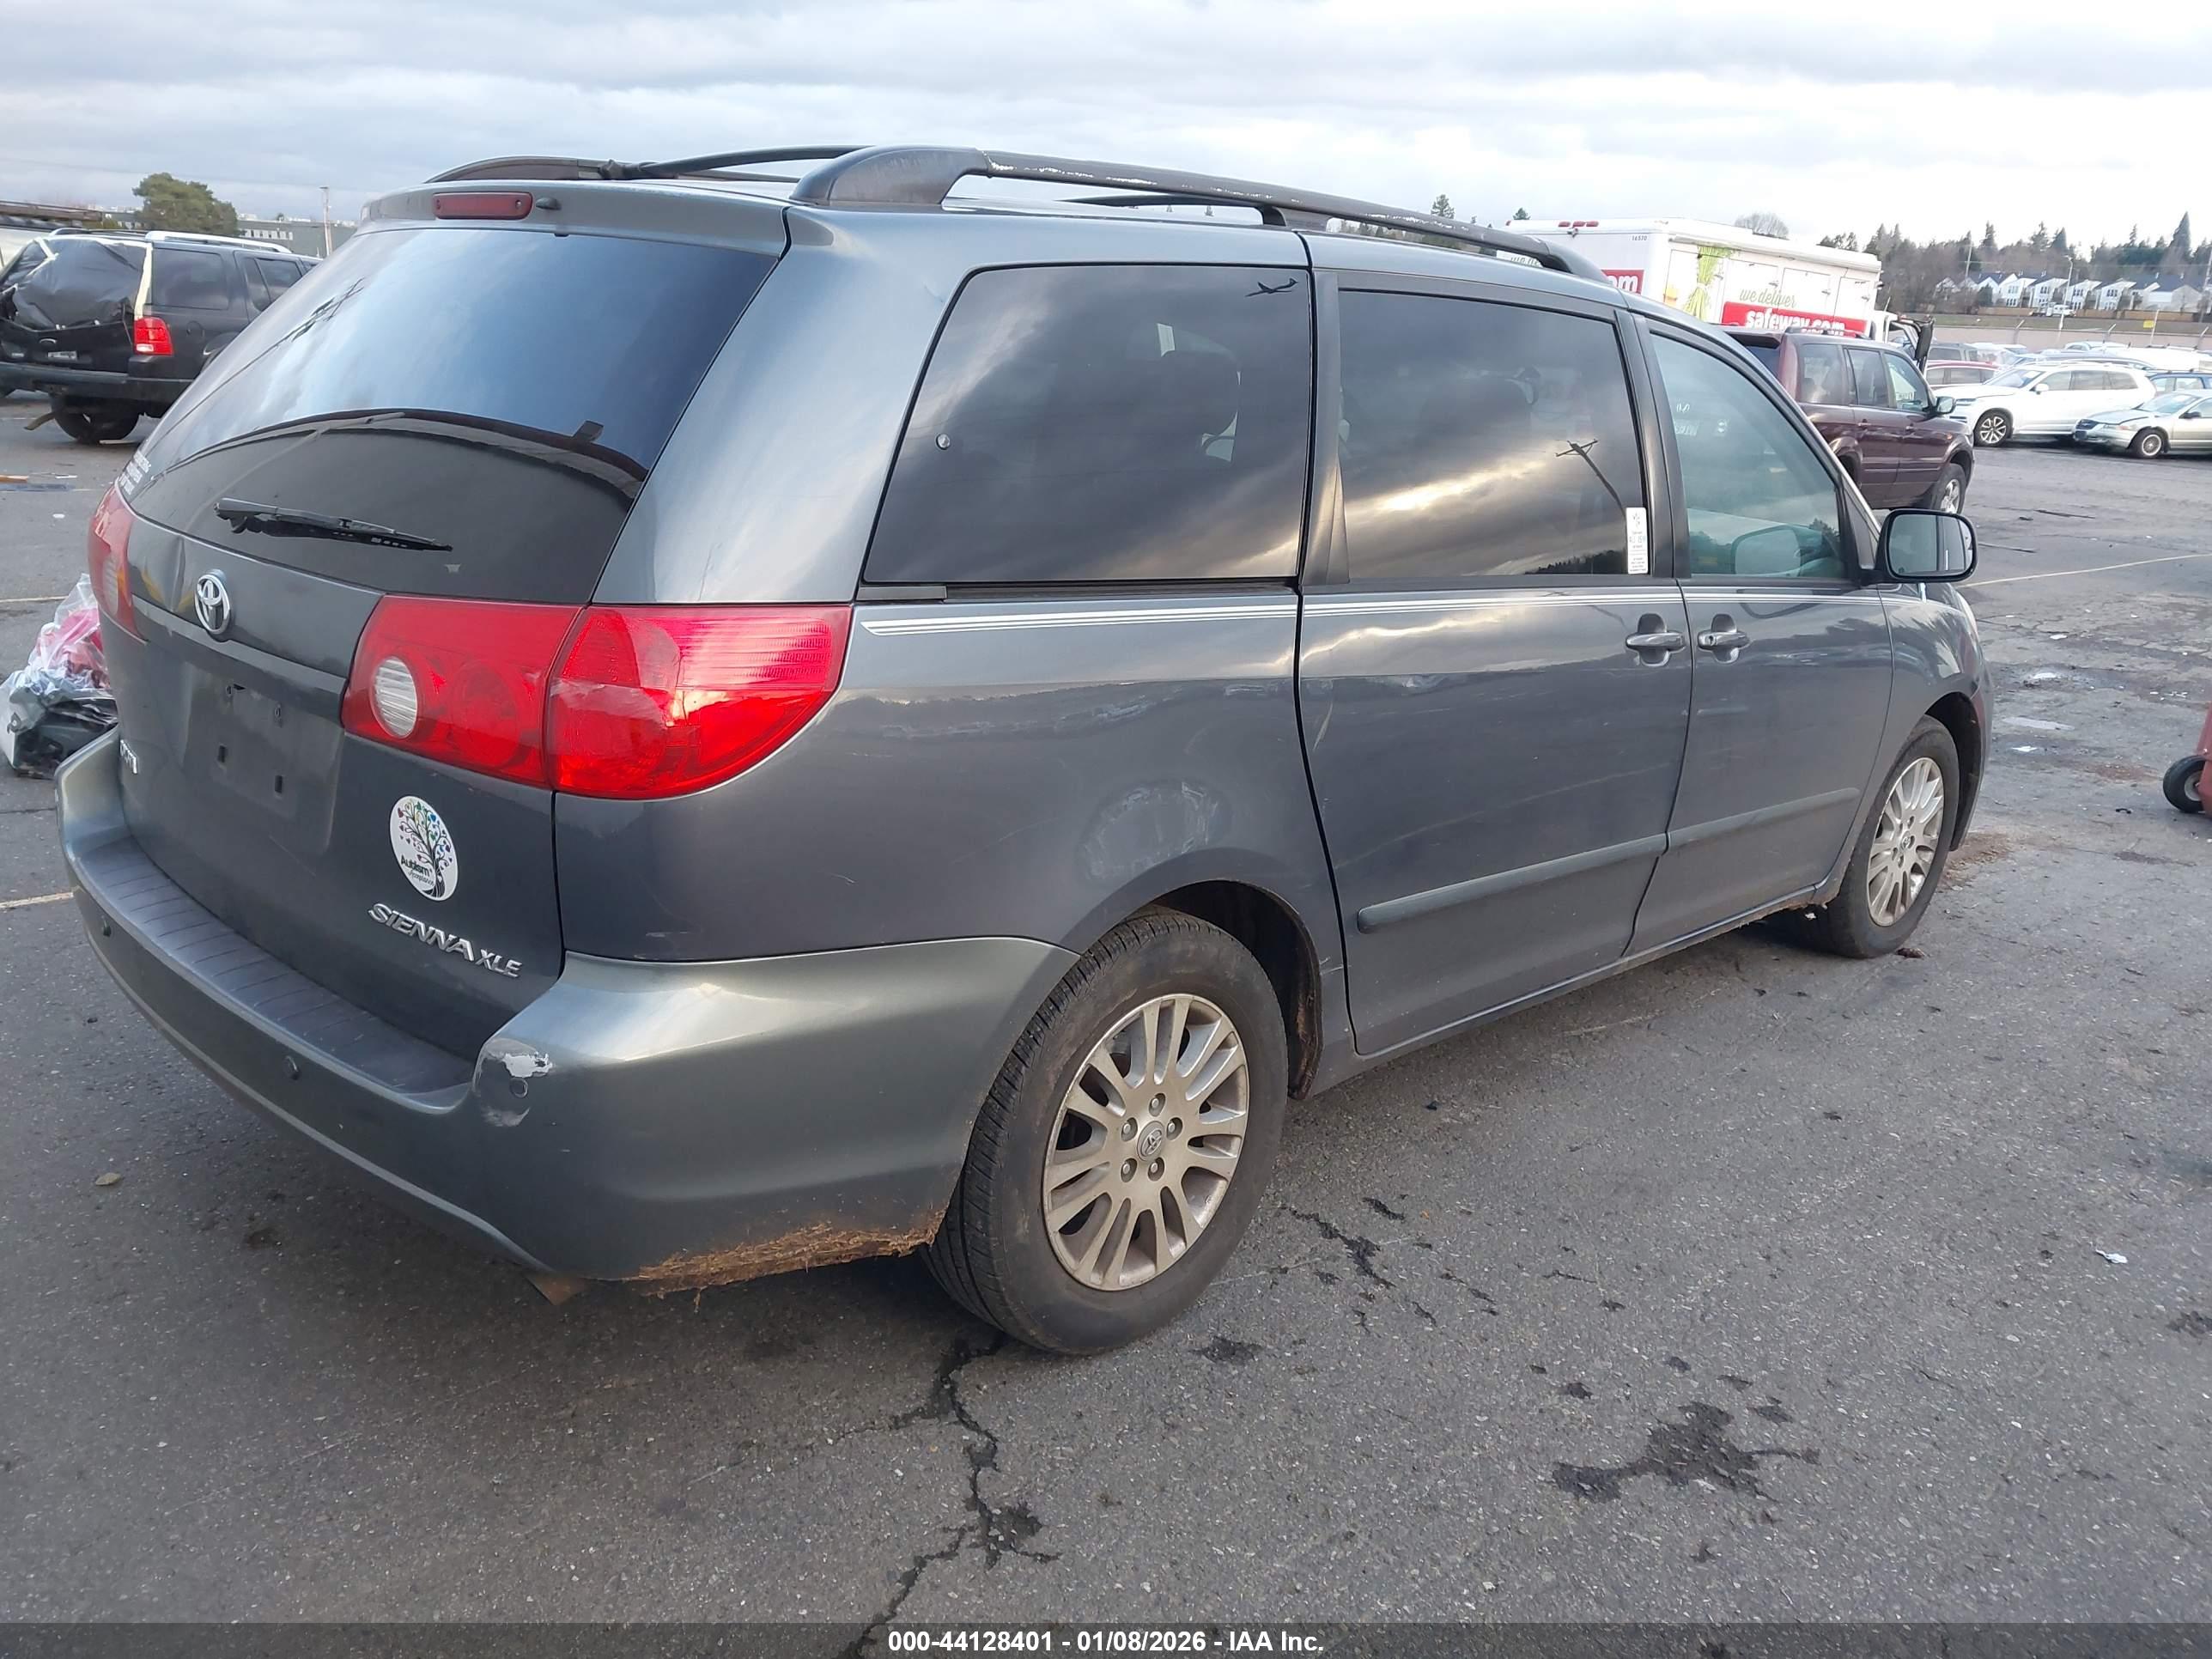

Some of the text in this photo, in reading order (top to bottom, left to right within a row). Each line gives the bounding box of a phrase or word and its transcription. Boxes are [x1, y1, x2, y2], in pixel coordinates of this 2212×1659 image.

[1740, 289, 1797, 307] we deliver
[401, 854, 430, 877] Autism
[368, 902, 523, 978] SIENNA XLE
